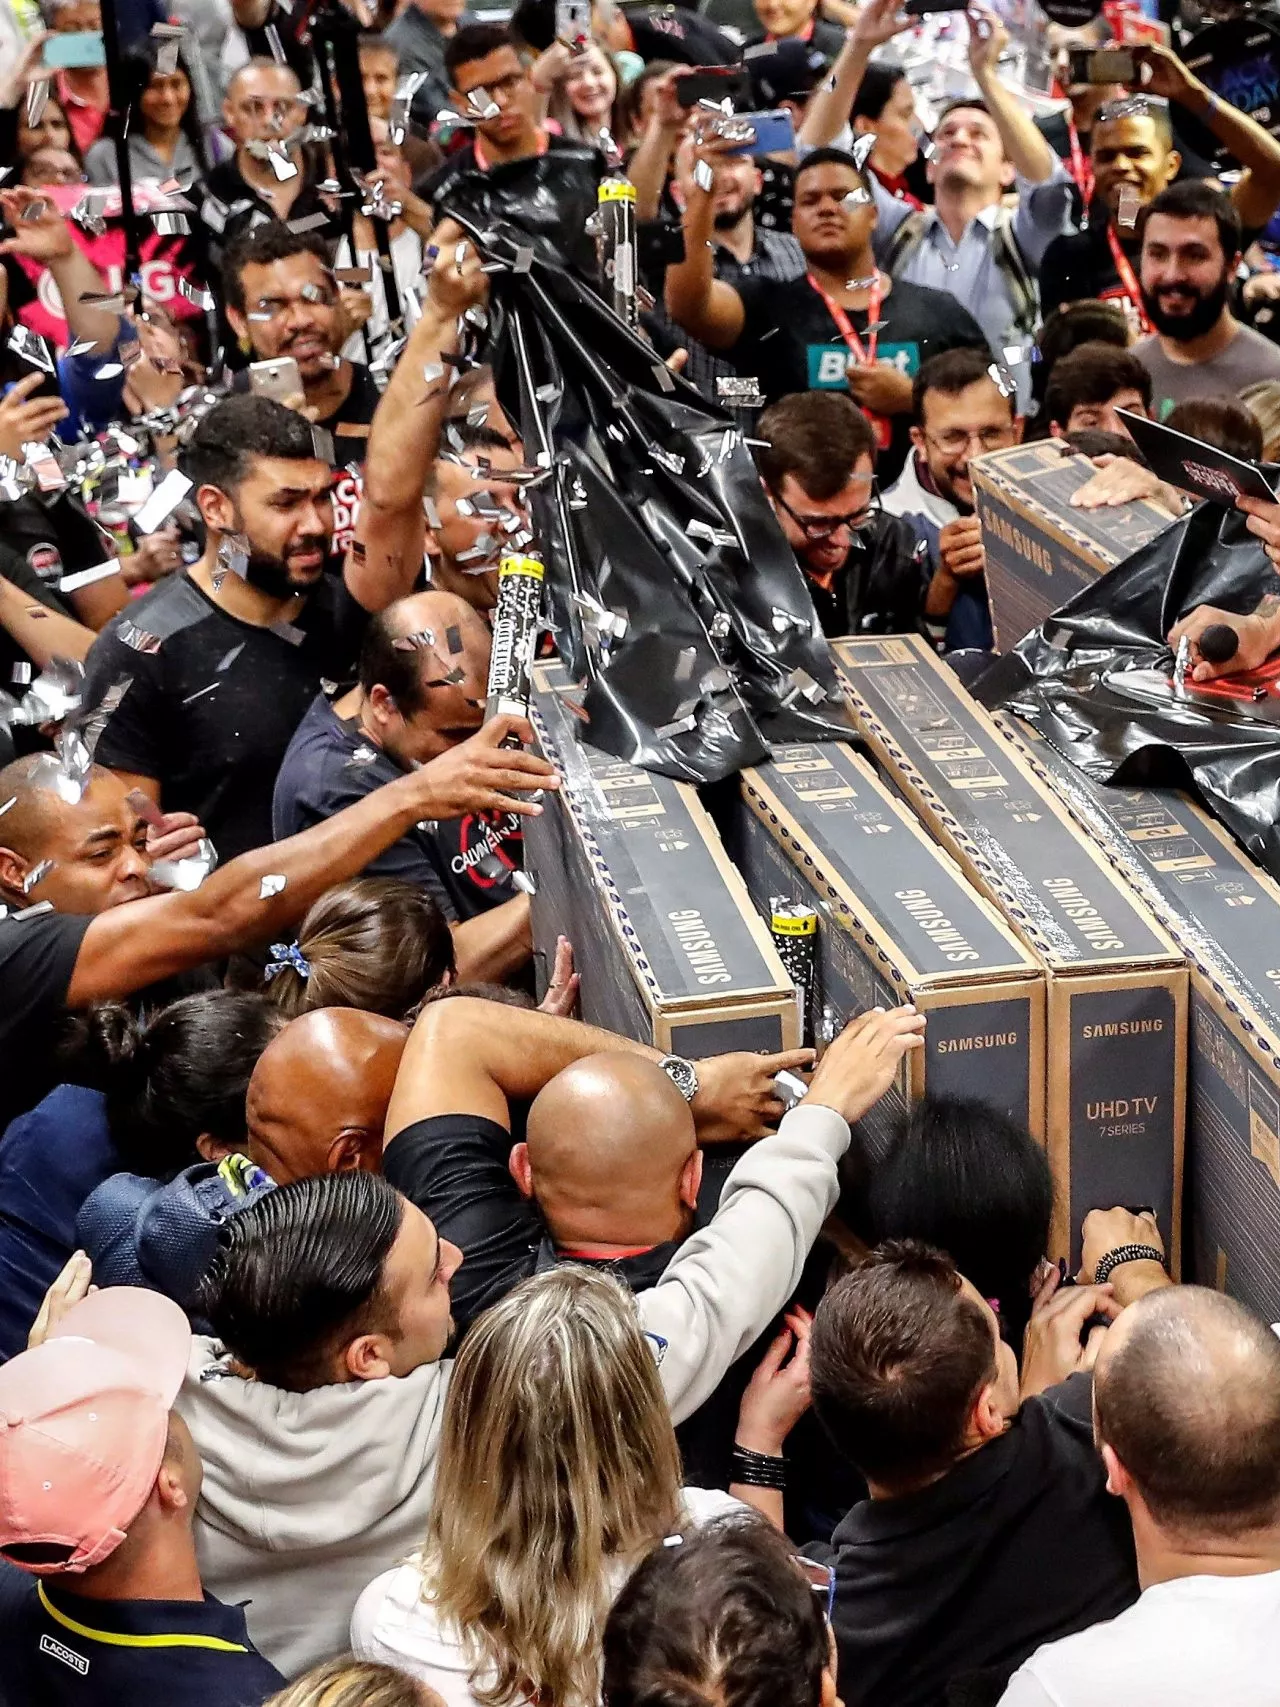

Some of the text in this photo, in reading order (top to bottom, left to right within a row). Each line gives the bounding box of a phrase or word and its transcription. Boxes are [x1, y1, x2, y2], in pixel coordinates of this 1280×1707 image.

[895, 889, 980, 962] SAMSUNG
[1043, 878, 1125, 951] SAMSUNG
[668, 908, 732, 985] SAMSUNG
[938, 1031, 1017, 1054] SAMSUNG
[1083, 1019, 1163, 1039] SAMSUNG
[1087, 1096, 1158, 1121] UHD TV
[44, 1638, 85, 1670] LACOSTE
